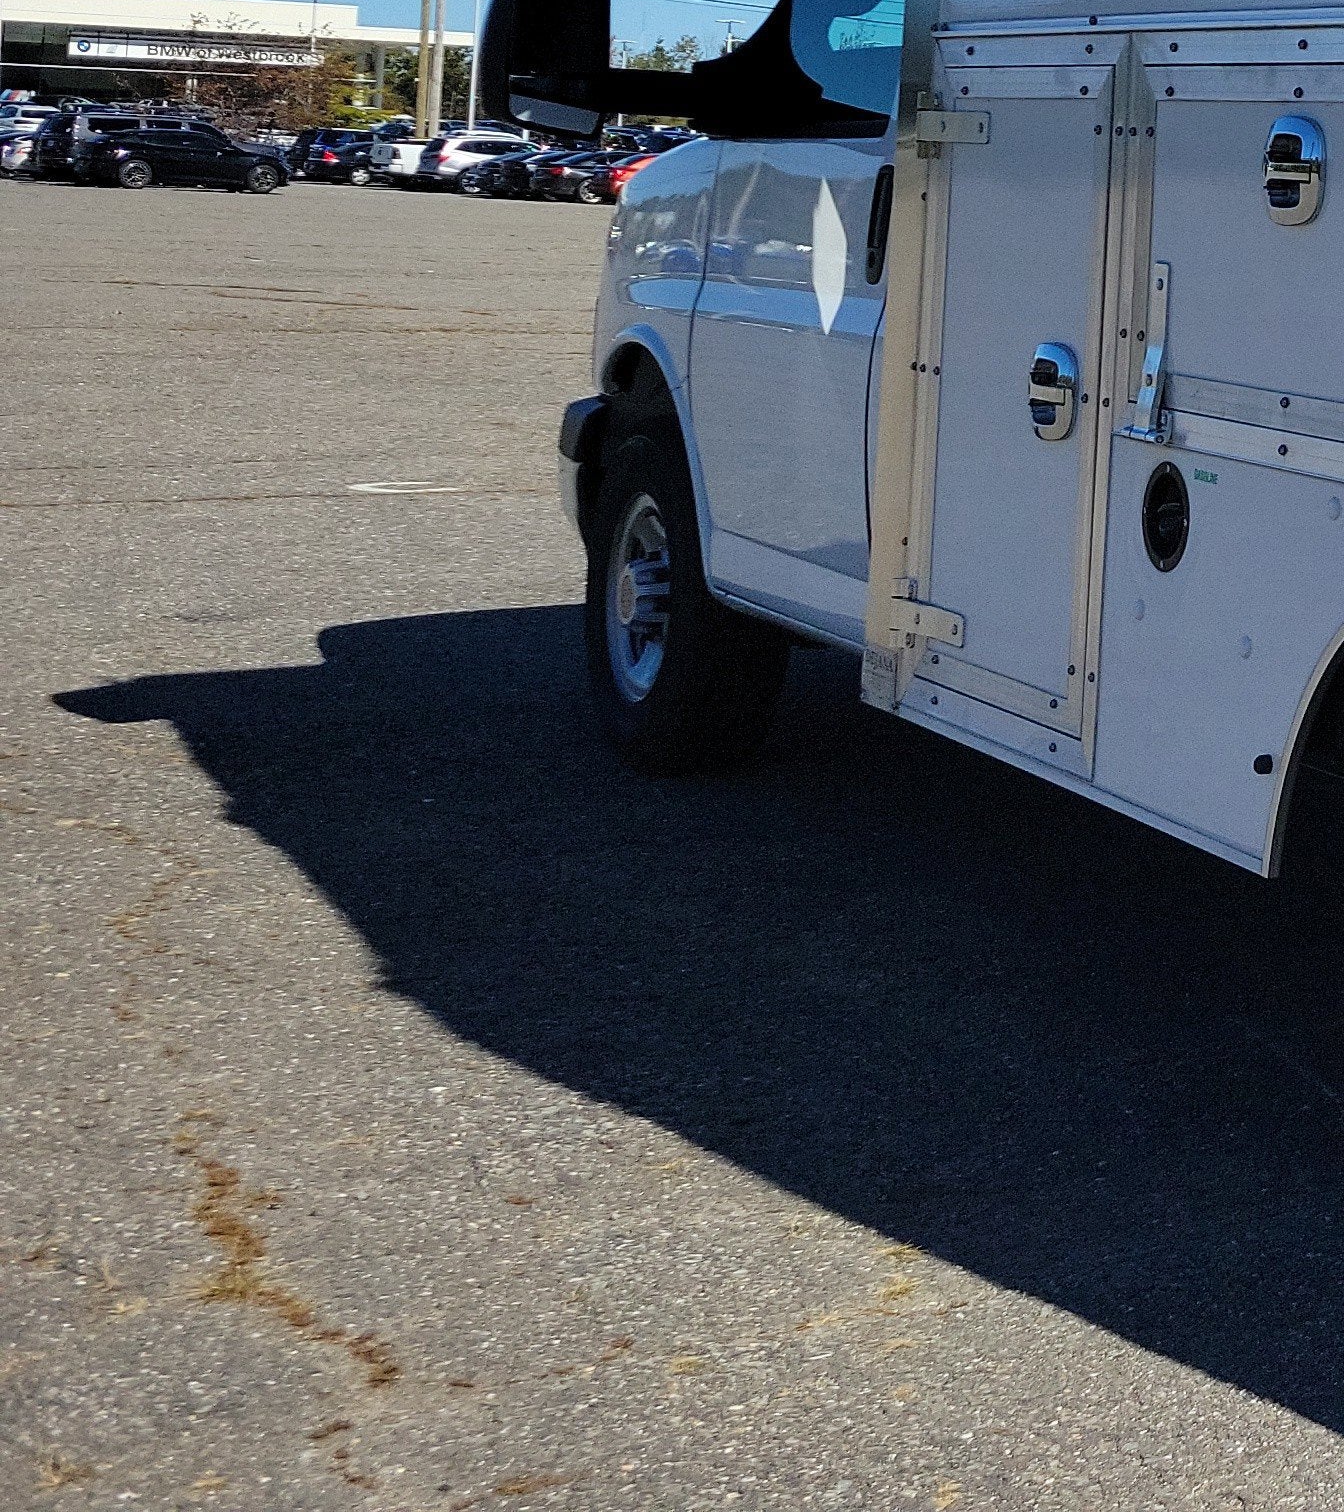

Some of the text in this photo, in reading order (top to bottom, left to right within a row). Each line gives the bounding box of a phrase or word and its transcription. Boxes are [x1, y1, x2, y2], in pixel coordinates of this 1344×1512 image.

[147, 44, 305, 64] BMW of Westbrook
